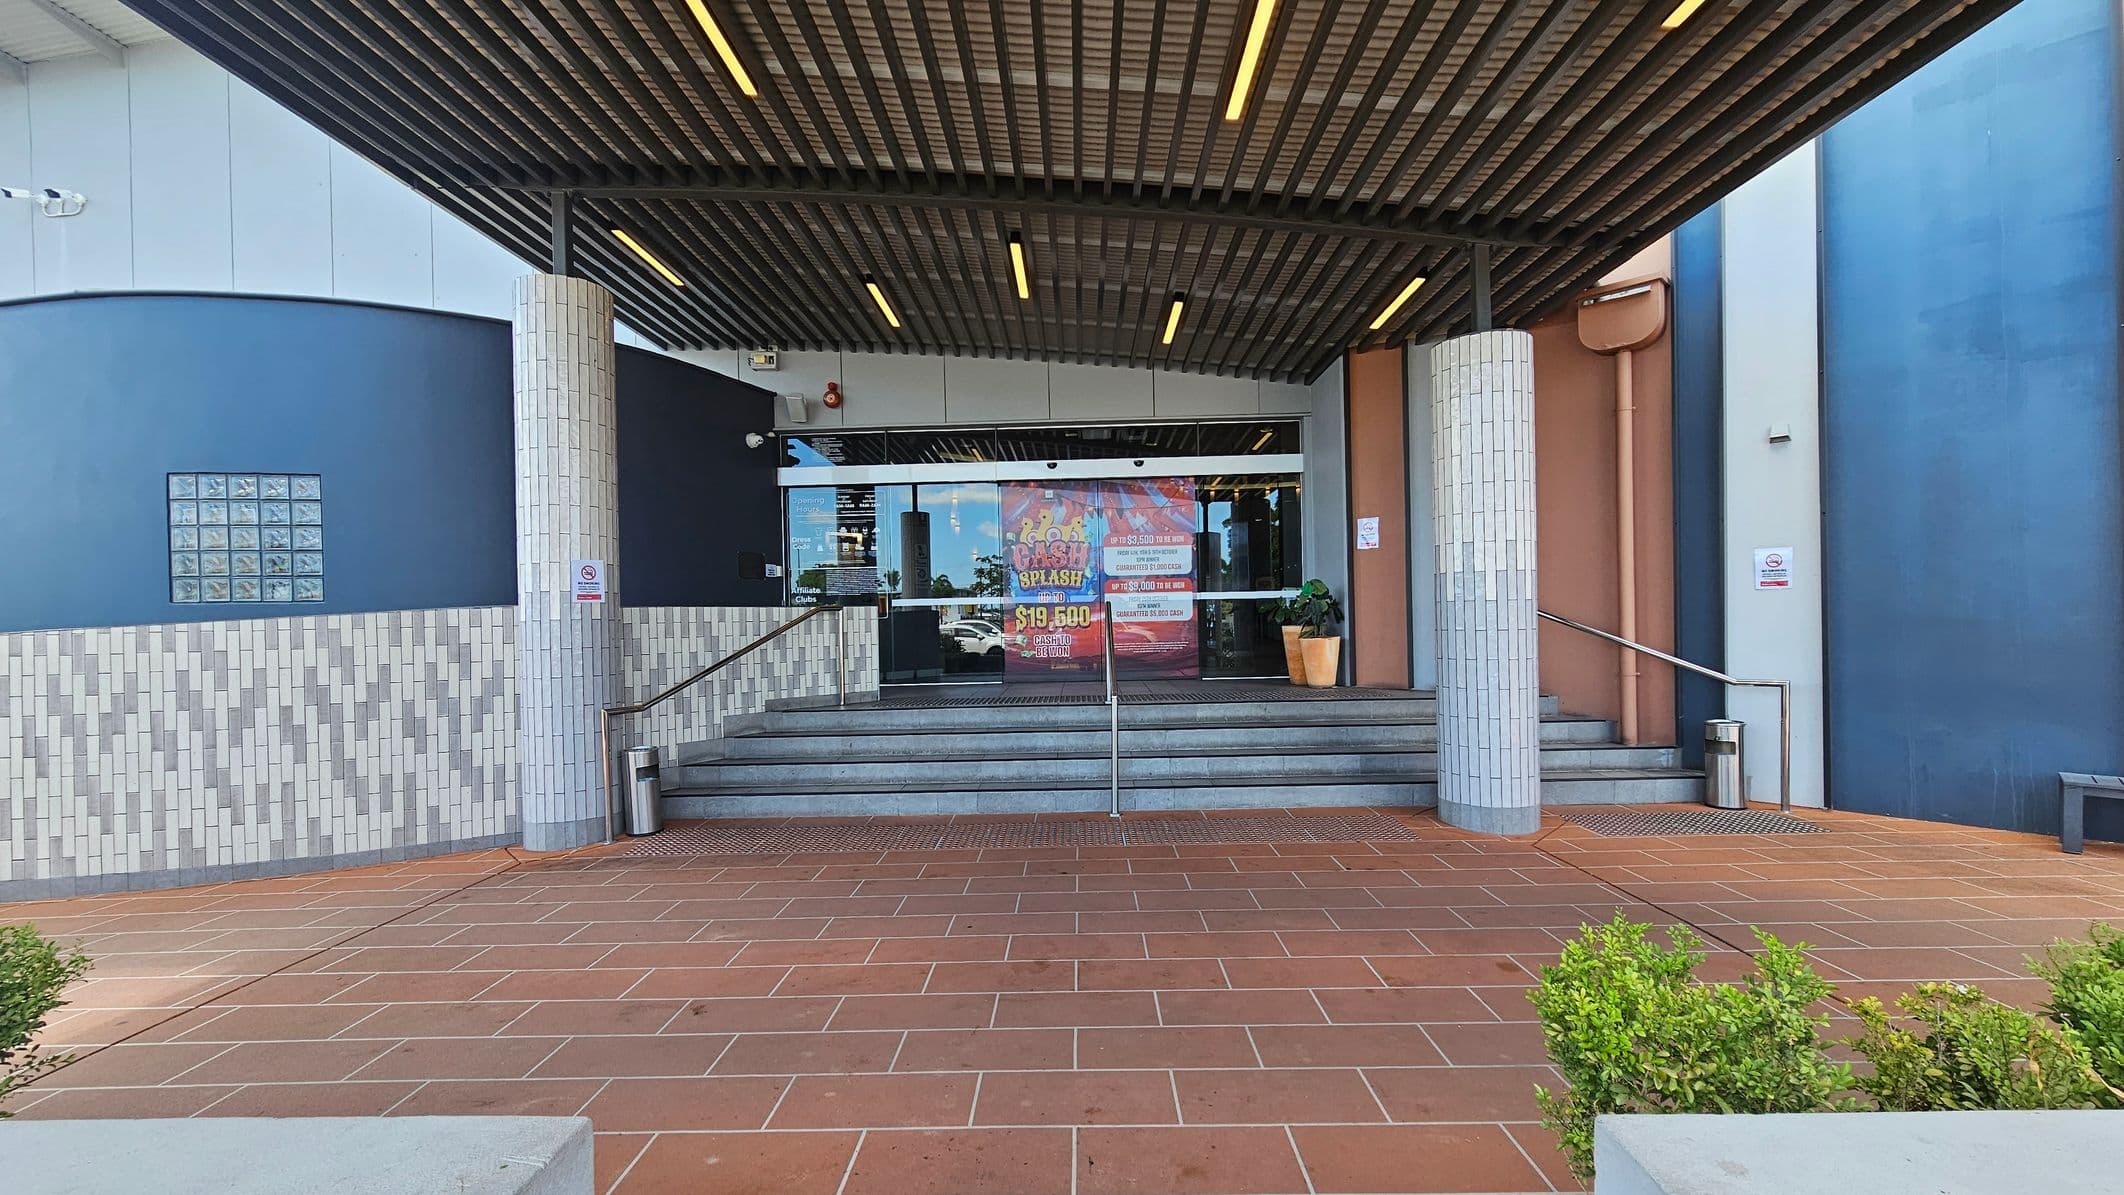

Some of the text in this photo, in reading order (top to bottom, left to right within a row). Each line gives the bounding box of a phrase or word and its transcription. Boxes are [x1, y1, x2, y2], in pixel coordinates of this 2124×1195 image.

[792, 496, 825, 506] Opening
[796, 505, 820, 513] Hours
[1127, 534, 1154, 545] $3,500
[1013, 540, 1090, 571] CASH
[1020, 569, 1083, 588] SPLASH
[791, 586, 821, 594] Affiliate
[1128, 581, 1156, 592] $9,000
[795, 595, 817, 603] Clubs
[1039, 592, 1065, 603] UP TO
[1015, 604, 1091, 632] $19,500
[1169, 609, 1184, 617] CASH
[1034, 634, 1072, 646] CASH TO
[1036, 646, 1070, 657] BE WON
